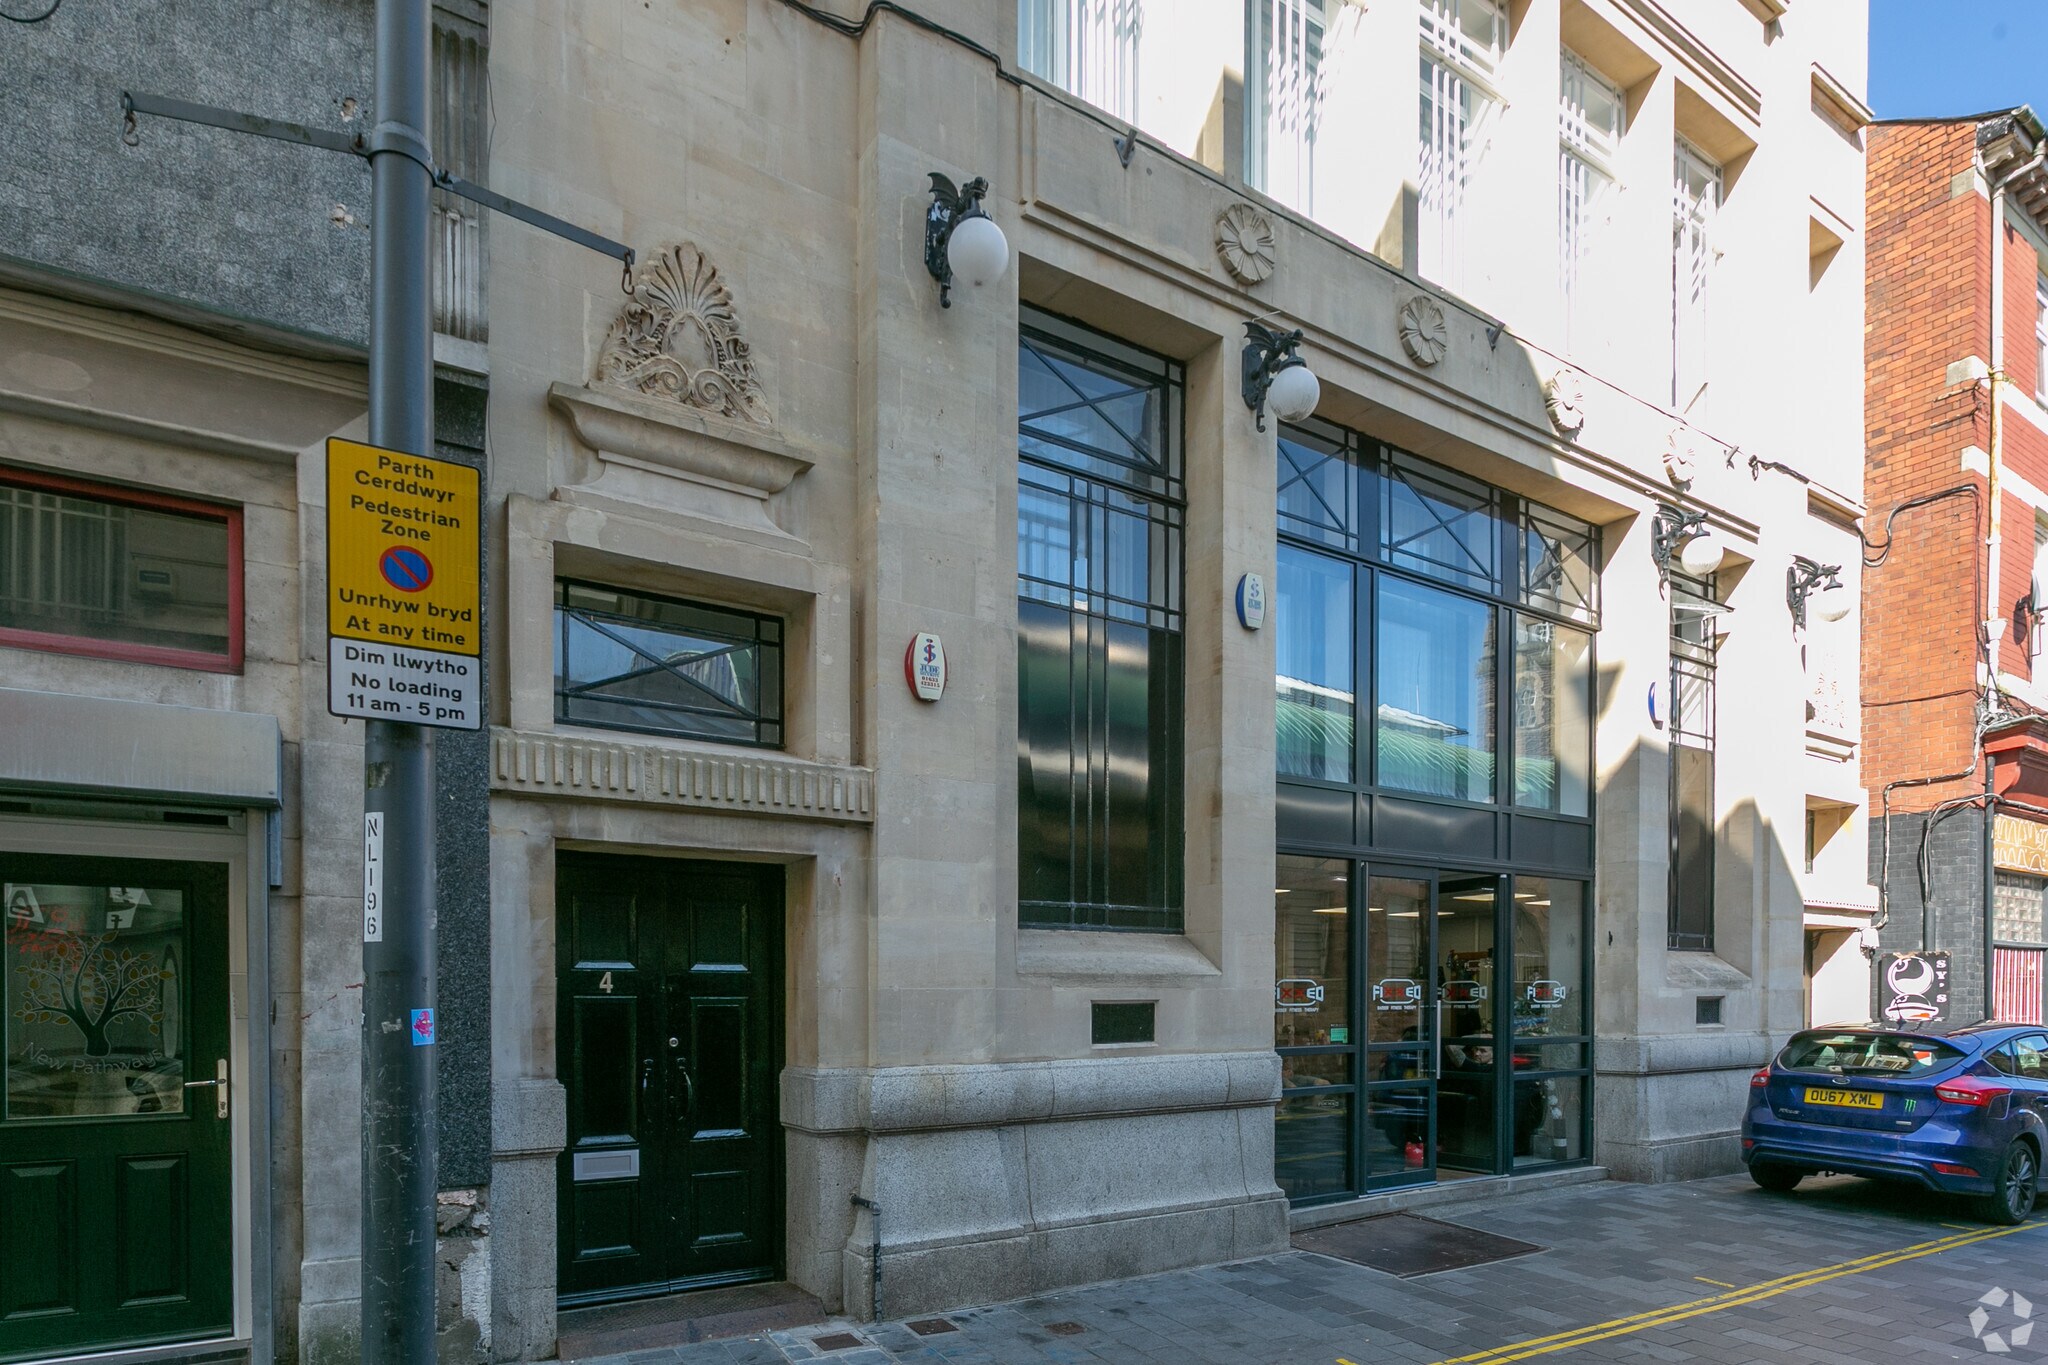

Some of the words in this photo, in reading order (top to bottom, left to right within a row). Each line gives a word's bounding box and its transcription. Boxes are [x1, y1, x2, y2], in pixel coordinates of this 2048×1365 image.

[378, 455, 434, 480] Parth
[355, 470, 455, 502] Cerddwyr
[351, 495, 460, 528] Pedestrian
[381, 519, 431, 541] Zone
[339, 588, 420, 614] Unrhyw
[427, 602, 472, 622] bryd
[346, 615, 371, 632] At
[378, 622, 414, 641] any
[422, 627, 466, 646] time
[345, 645, 385, 665] Dim
[393, 653, 468, 676] llwytho
[351, 672, 381, 690] No
[389, 677, 462, 702] loading
[347, 693, 364, 709] 11
[371, 697, 401, 713] am
[418, 701, 431, 716] 5
[435, 705, 466, 721] pm
[600, 971, 614, 994] 4
[1275, 985, 1325, 1002] IXXED
[1372, 984, 1421, 1001] FIXXED
[19, 1041, 66, 1071] New
[72, 1047, 163, 1076] Pathways
[1810, 1089, 1846, 1104] OU67
[1848, 1092, 1877, 1106] XML
